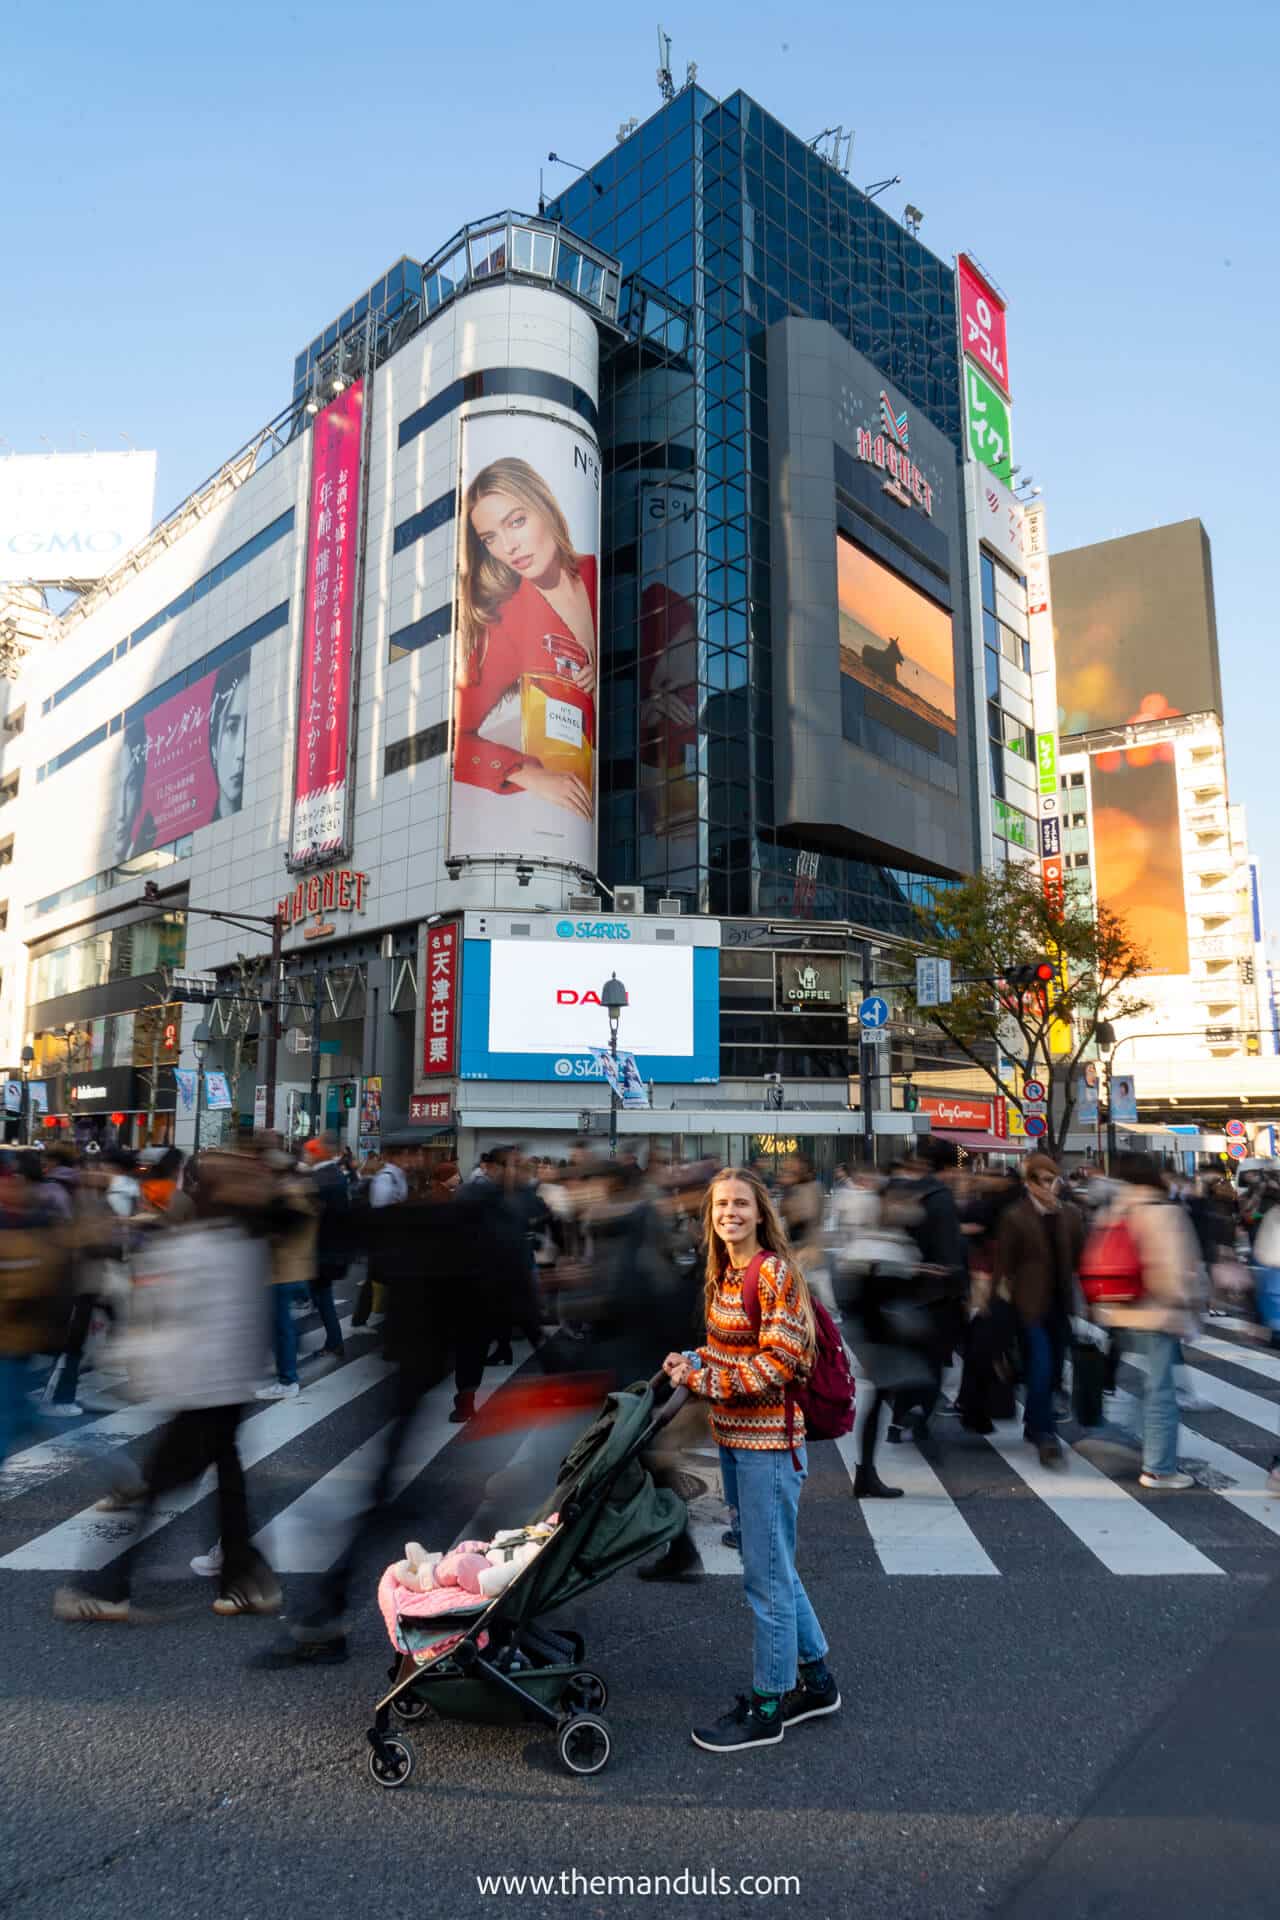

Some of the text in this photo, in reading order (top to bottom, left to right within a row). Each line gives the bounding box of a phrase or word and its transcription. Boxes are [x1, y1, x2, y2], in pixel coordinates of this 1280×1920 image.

[966, 313, 1005, 378] アコム
[971, 376, 1004, 463] レイク
[857, 426, 933, 517] MAGNET
[7, 528, 123, 555] GMO
[549, 711, 581, 729] CHANEL
[277, 869, 367, 927] MAGNET
[575, 921, 631, 940] STARTS
[429, 951, 451, 1063] 天津甘栗
[788, 989, 831, 1000] COFFEE
[411, 1101, 449, 1118] 天津甘栗
